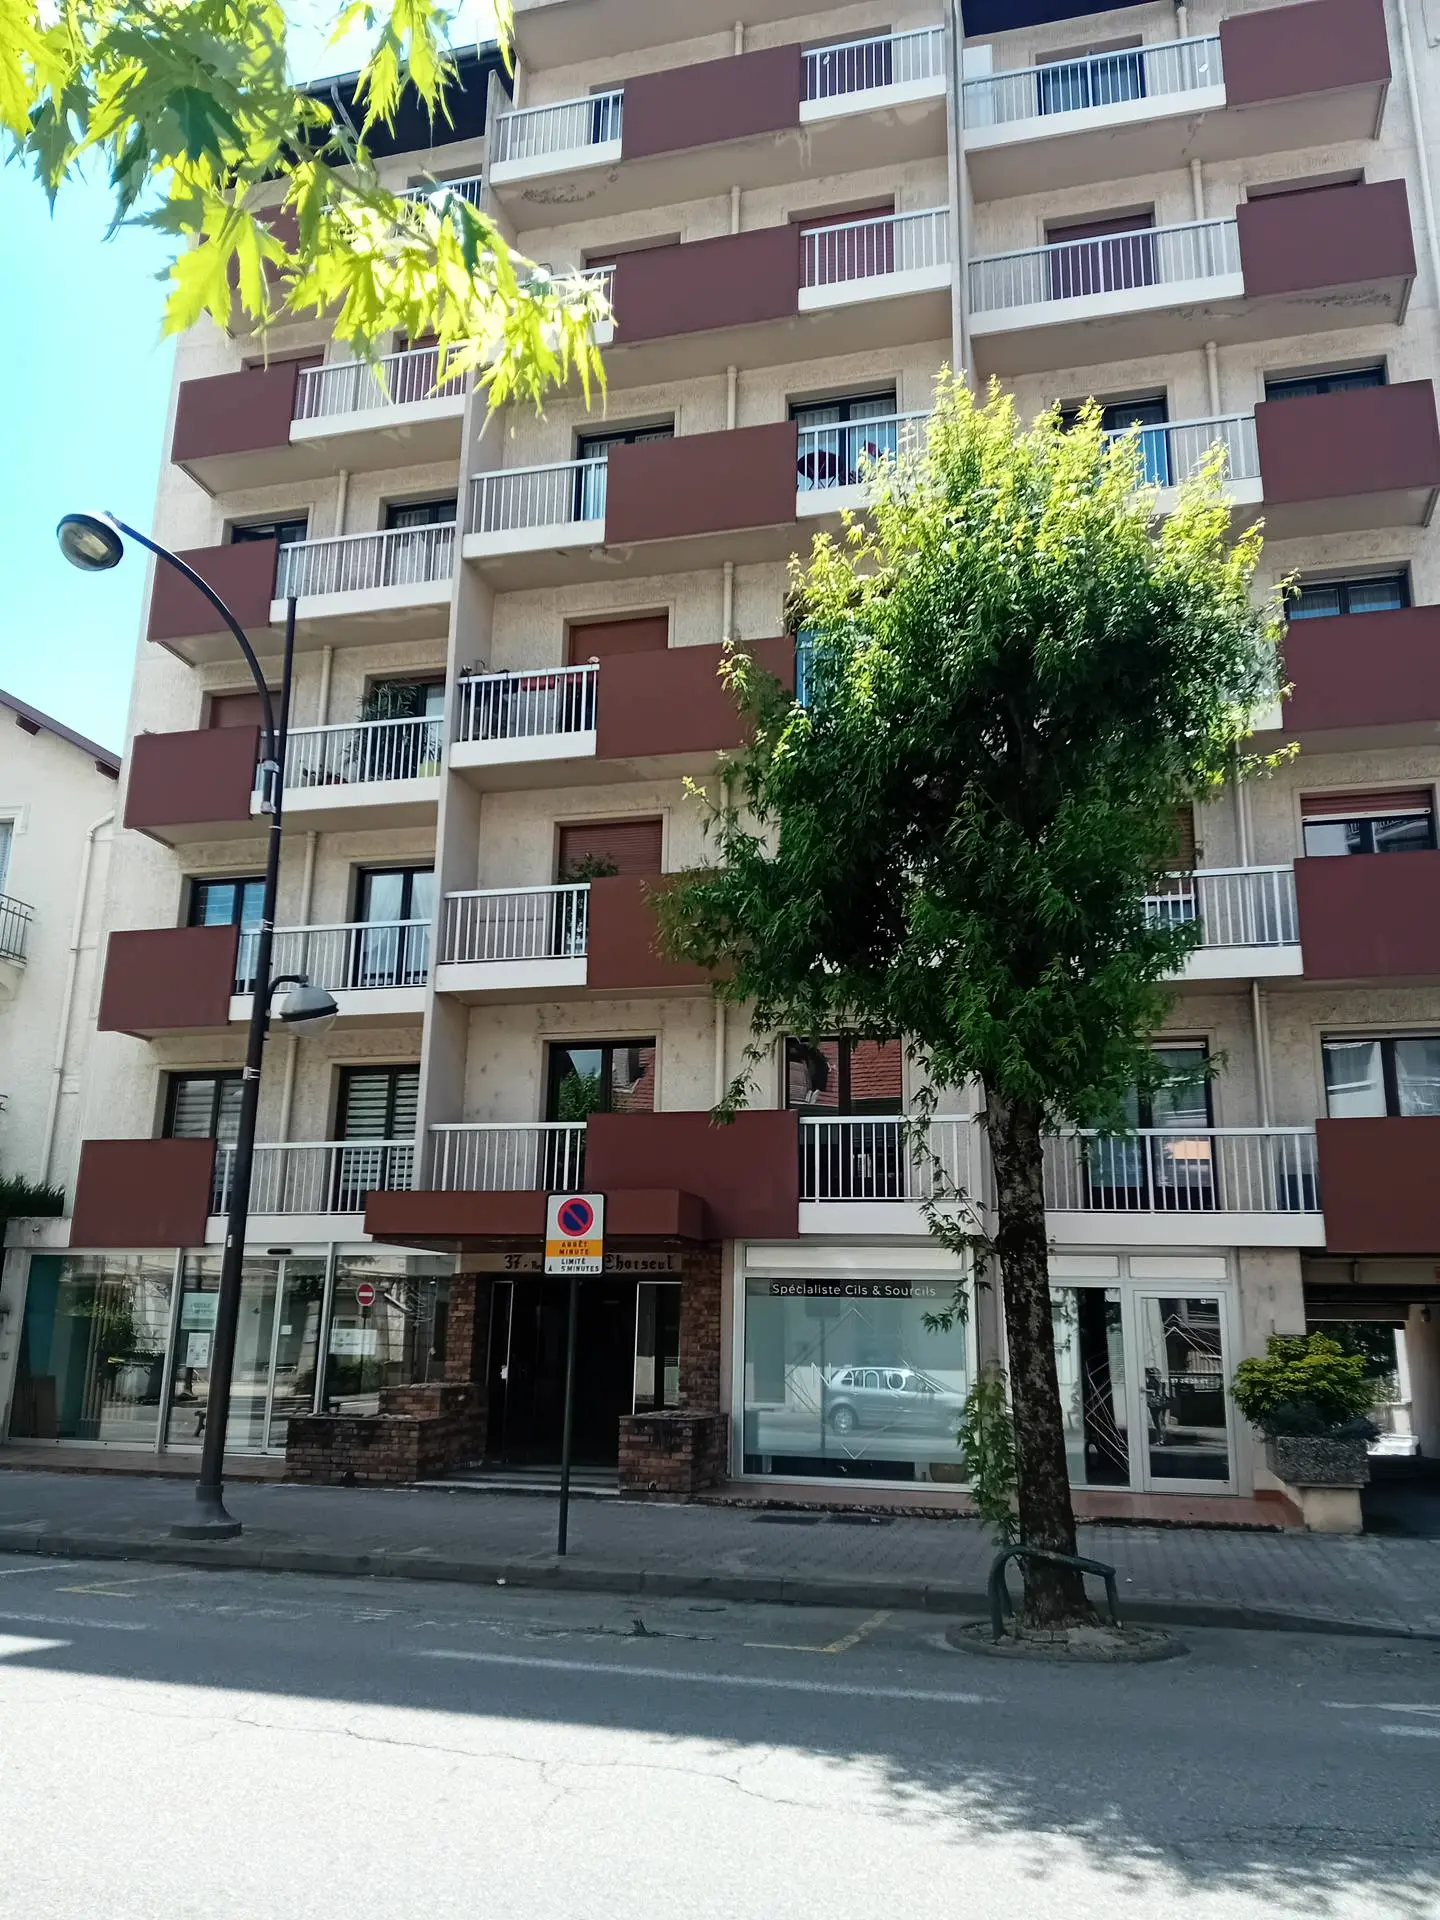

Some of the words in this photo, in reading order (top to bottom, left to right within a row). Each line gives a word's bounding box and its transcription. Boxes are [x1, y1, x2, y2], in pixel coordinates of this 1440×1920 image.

[772, 1284, 841, 1296] Spécialiste
[845, 1285, 868, 1296] Cils
[872, 1286, 880, 1295] &
[884, 1286, 936, 1297] Sourcils
